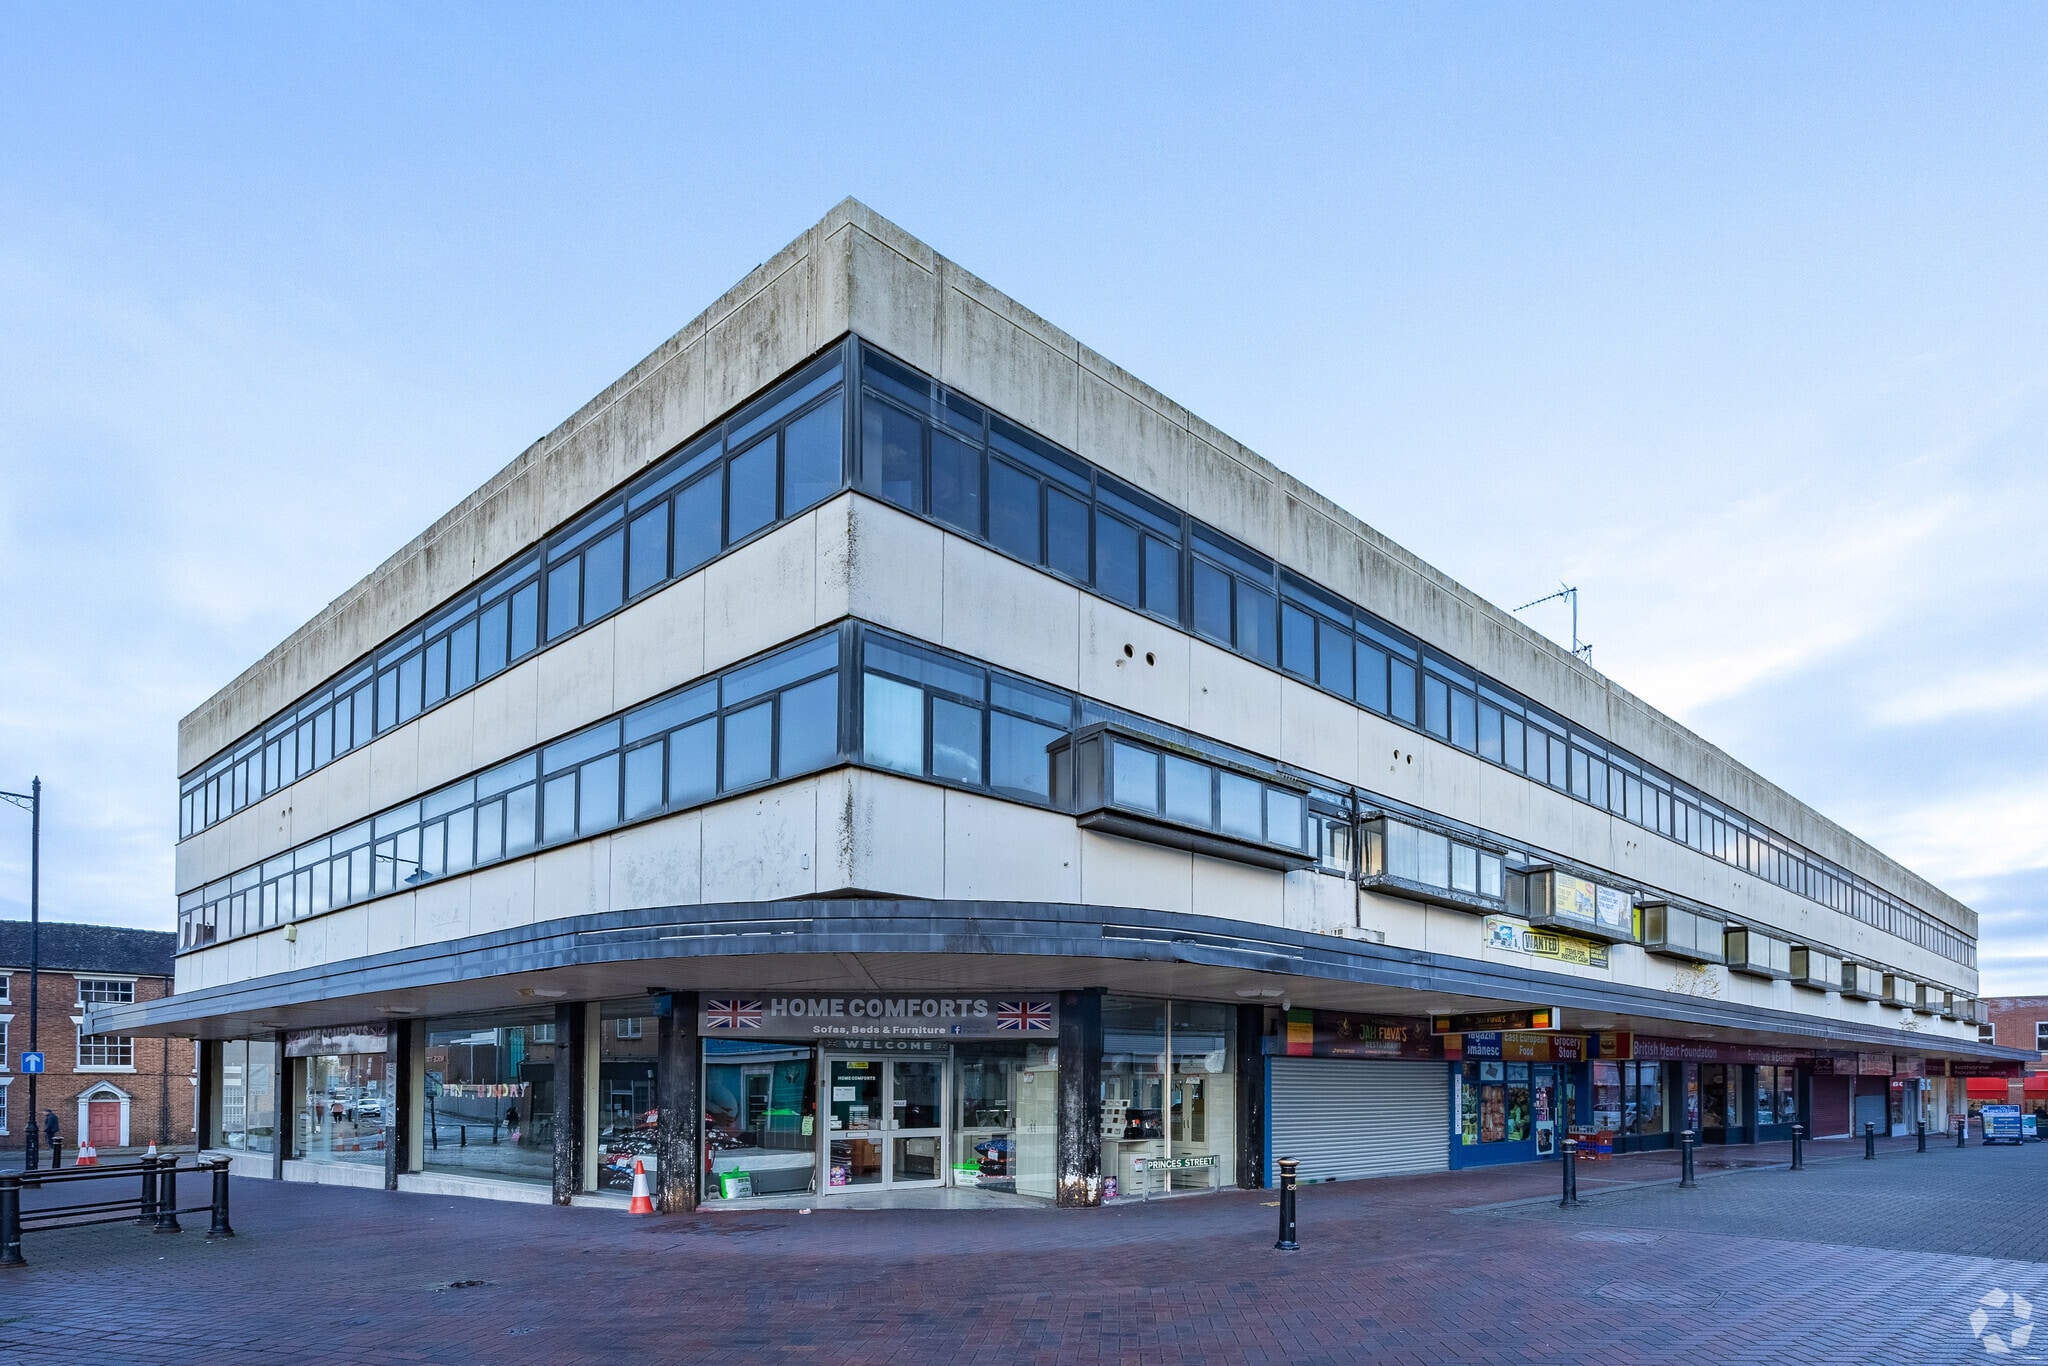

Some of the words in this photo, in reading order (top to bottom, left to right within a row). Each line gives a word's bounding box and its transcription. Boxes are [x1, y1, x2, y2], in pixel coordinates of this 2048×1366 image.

[1525, 934, 1557, 952] WANTED
[1561, 953, 1578, 961] INSTANT
[1565, 948, 1577, 956] ITEMS
[771, 998, 844, 1017] HOME
[849, 998, 988, 1018] COMFORTS
[813, 1025, 850, 1035] Sofas,
[852, 1026, 880, 1034] Beds
[882, 1026, 890, 1034] &
[893, 1026, 946, 1034] Furniture
[1359, 1024, 1377, 1040] JAH
[1379, 1026, 1407, 1042] FLAVA'S
[300, 1029, 321, 1045] HOME
[1468, 1032, 1495, 1042] agazin
[1504, 1033, 1518, 1042] East
[1520, 1033, 1547, 1045] European
[1554, 1036, 1580, 1049] Grocery
[845, 1040, 932, 1050] WELCOME
[1365, 1041, 1401, 1049] RESTAURANT
[1467, 1043, 1499, 1056] mânesc
[1520, 1045, 1534, 1056] Food
[1634, 1041, 1658, 1055] British
[1660, 1043, 1679, 1056] Heart
[1681, 1045, 1717, 1058] Foundation
[1559, 1046, 1576, 1058] Store
[1148, 1160, 1181, 1169] PRINCES
[1184, 1158, 1213, 1166] STREET
